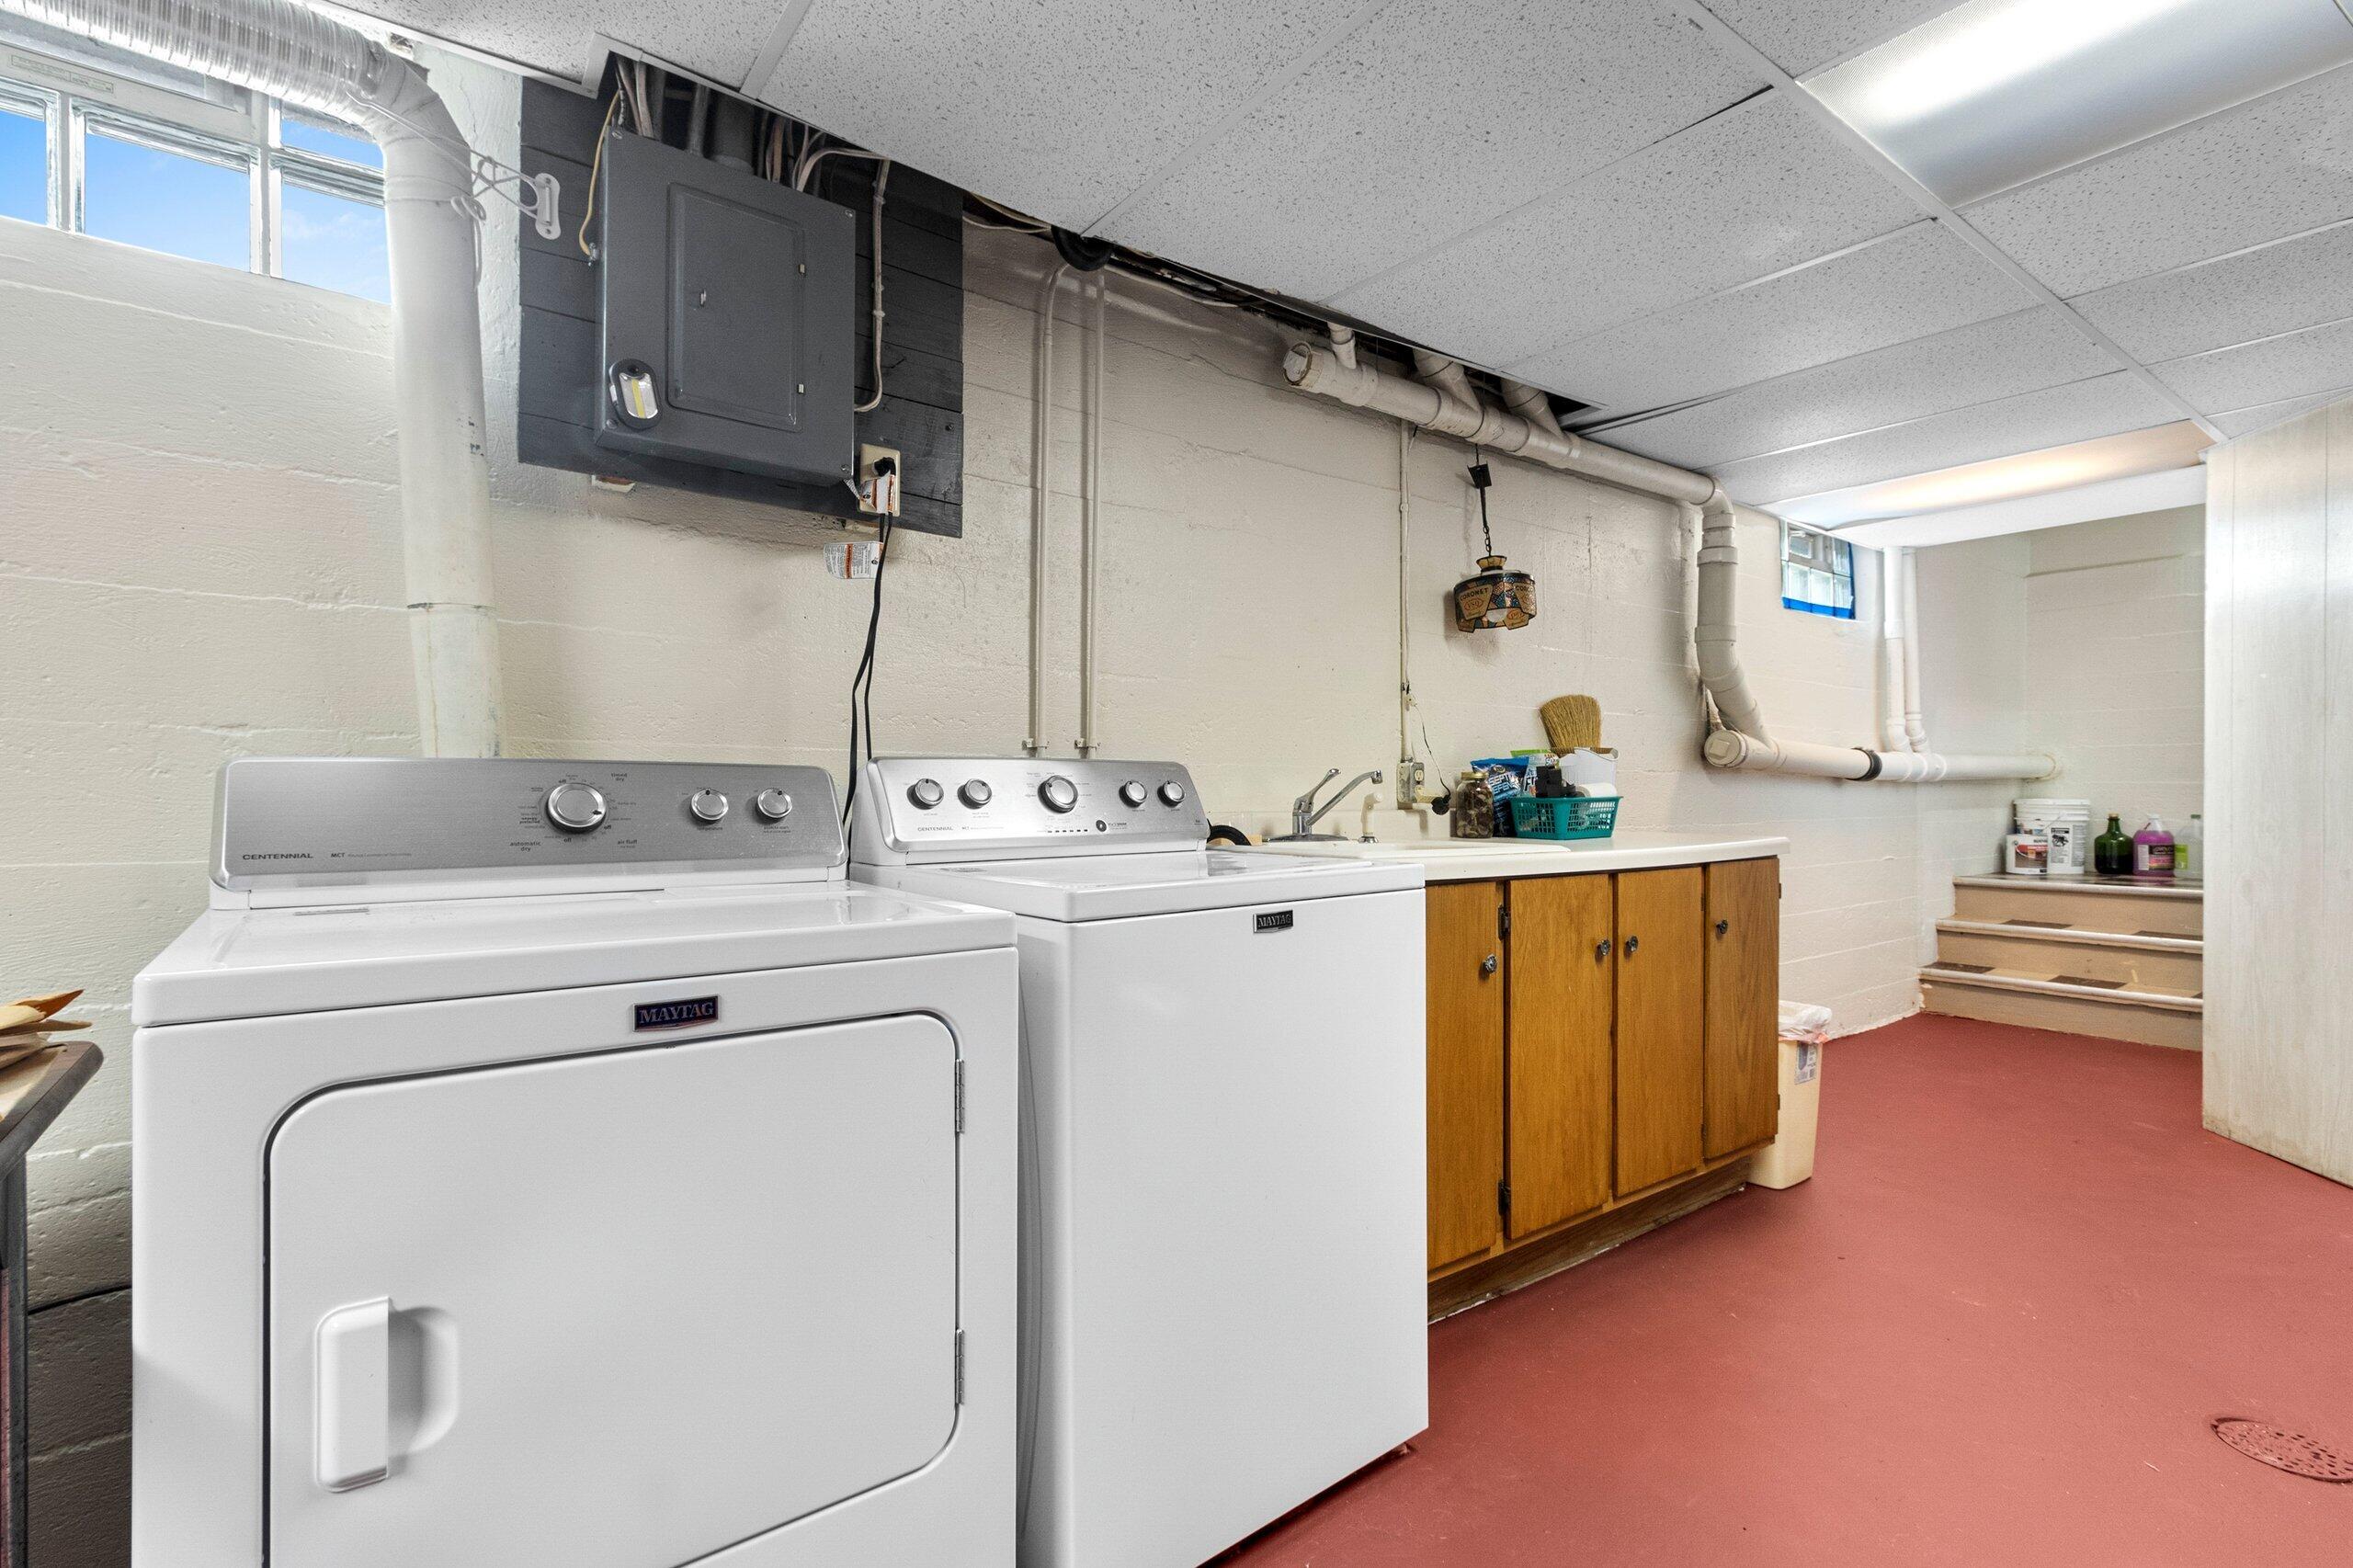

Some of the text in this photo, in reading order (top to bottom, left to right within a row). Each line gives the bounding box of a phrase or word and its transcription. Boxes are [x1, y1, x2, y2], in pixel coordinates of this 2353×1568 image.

[1460, 587, 1489, 601] CORONET
[242, 852, 313, 860] CENTENNIAL
[1258, 915, 1291, 926] MAYTAG
[639, 1002, 714, 1024] MAYTAG
